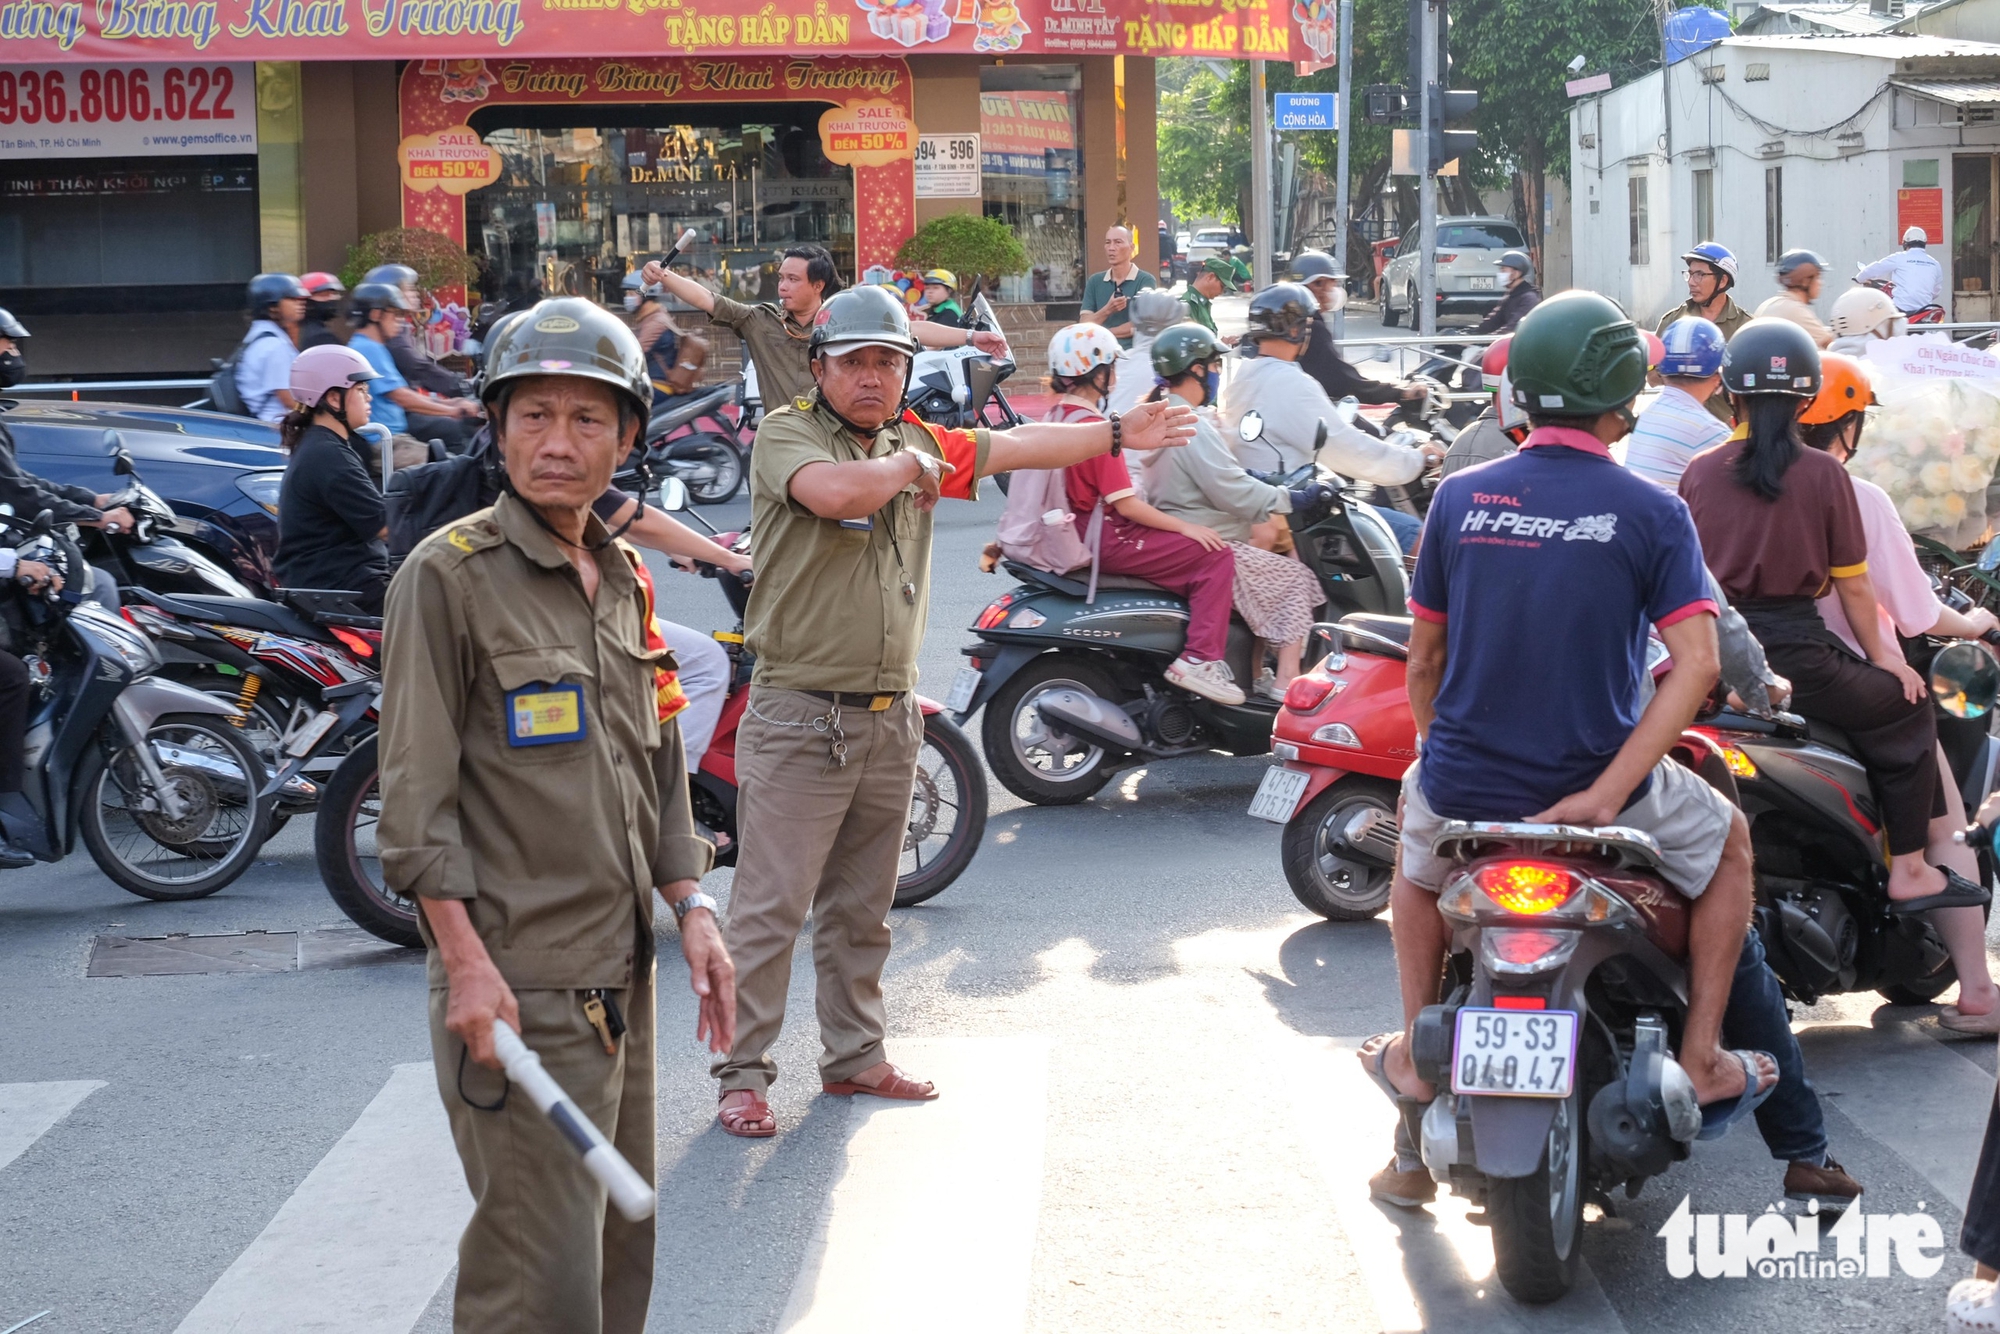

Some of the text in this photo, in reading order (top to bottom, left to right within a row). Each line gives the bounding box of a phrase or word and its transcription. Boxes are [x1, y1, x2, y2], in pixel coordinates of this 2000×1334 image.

[664, 0, 850, 53] TẶNG HẤP DẪN
[1124, 13, 1289, 54] TẶNG HẤP DẪN
[502, 61, 900, 97] Tưng Bừng Khai Trương
[1290, 96, 1320, 106] ĐƯỜNG
[857, 107, 892, 118] SALE
[1283, 111, 1326, 128] CỘNG HÒA
[828, 121, 907, 130] KHAI TRƯƠNG
[66, 137, 80, 147] Chí
[82, 138, 101, 147] Minh
[152, 132, 252, 148] www.gemsoffice.vn
[438, 135, 474, 146] SALE
[834, 133, 903, 149] ĐẾN 50%
[407, 148, 488, 158] KHAI TRƯƠNG
[950, 140, 974, 160] 596
[413, 161, 485, 177] ĐẾN 50%
[1472, 492, 1522, 507] TOTAL
[1460, 510, 1569, 538] HI-PERF
[1062, 628, 1122, 638] SCOOPY
[1268, 770, 1302, 796] 47-C1
[1253, 792, 1296, 820] 075.77
[1475, 1016, 1558, 1051] 59-S3
[1461, 1053, 1566, 1090] 040.47
